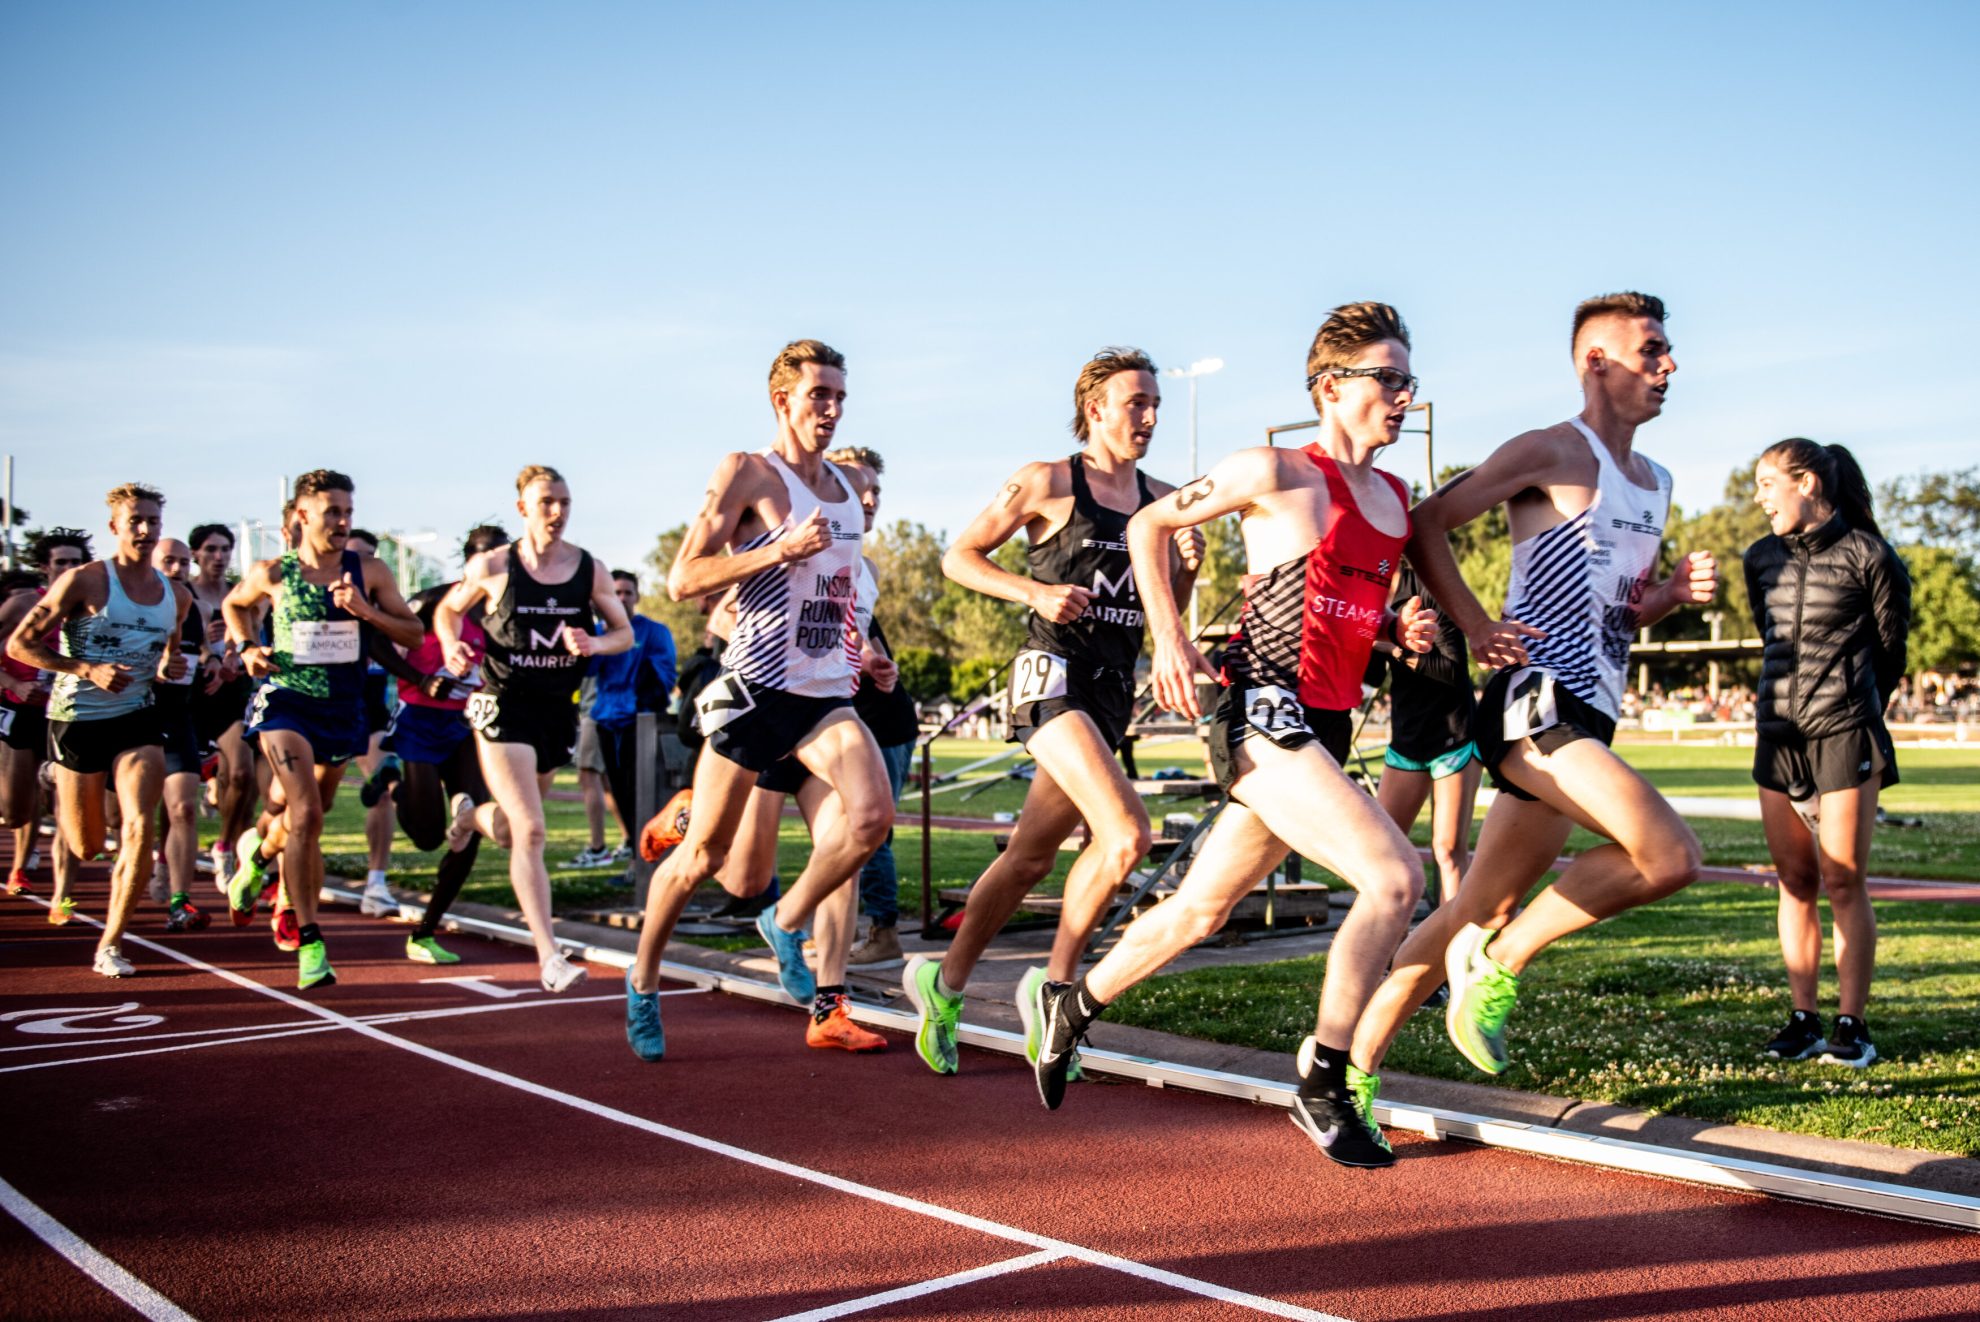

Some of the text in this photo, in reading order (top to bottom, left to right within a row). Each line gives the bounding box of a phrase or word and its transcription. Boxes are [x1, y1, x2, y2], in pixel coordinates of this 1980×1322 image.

[1611, 518, 1663, 537] STEIG
[1081, 538, 1129, 552] STEI
[1083, 605, 1145, 627] AURTEN
[1020, 654, 1052, 699] 29
[701, 679, 751, 715] 7
[1251, 696, 1307, 730] 23
